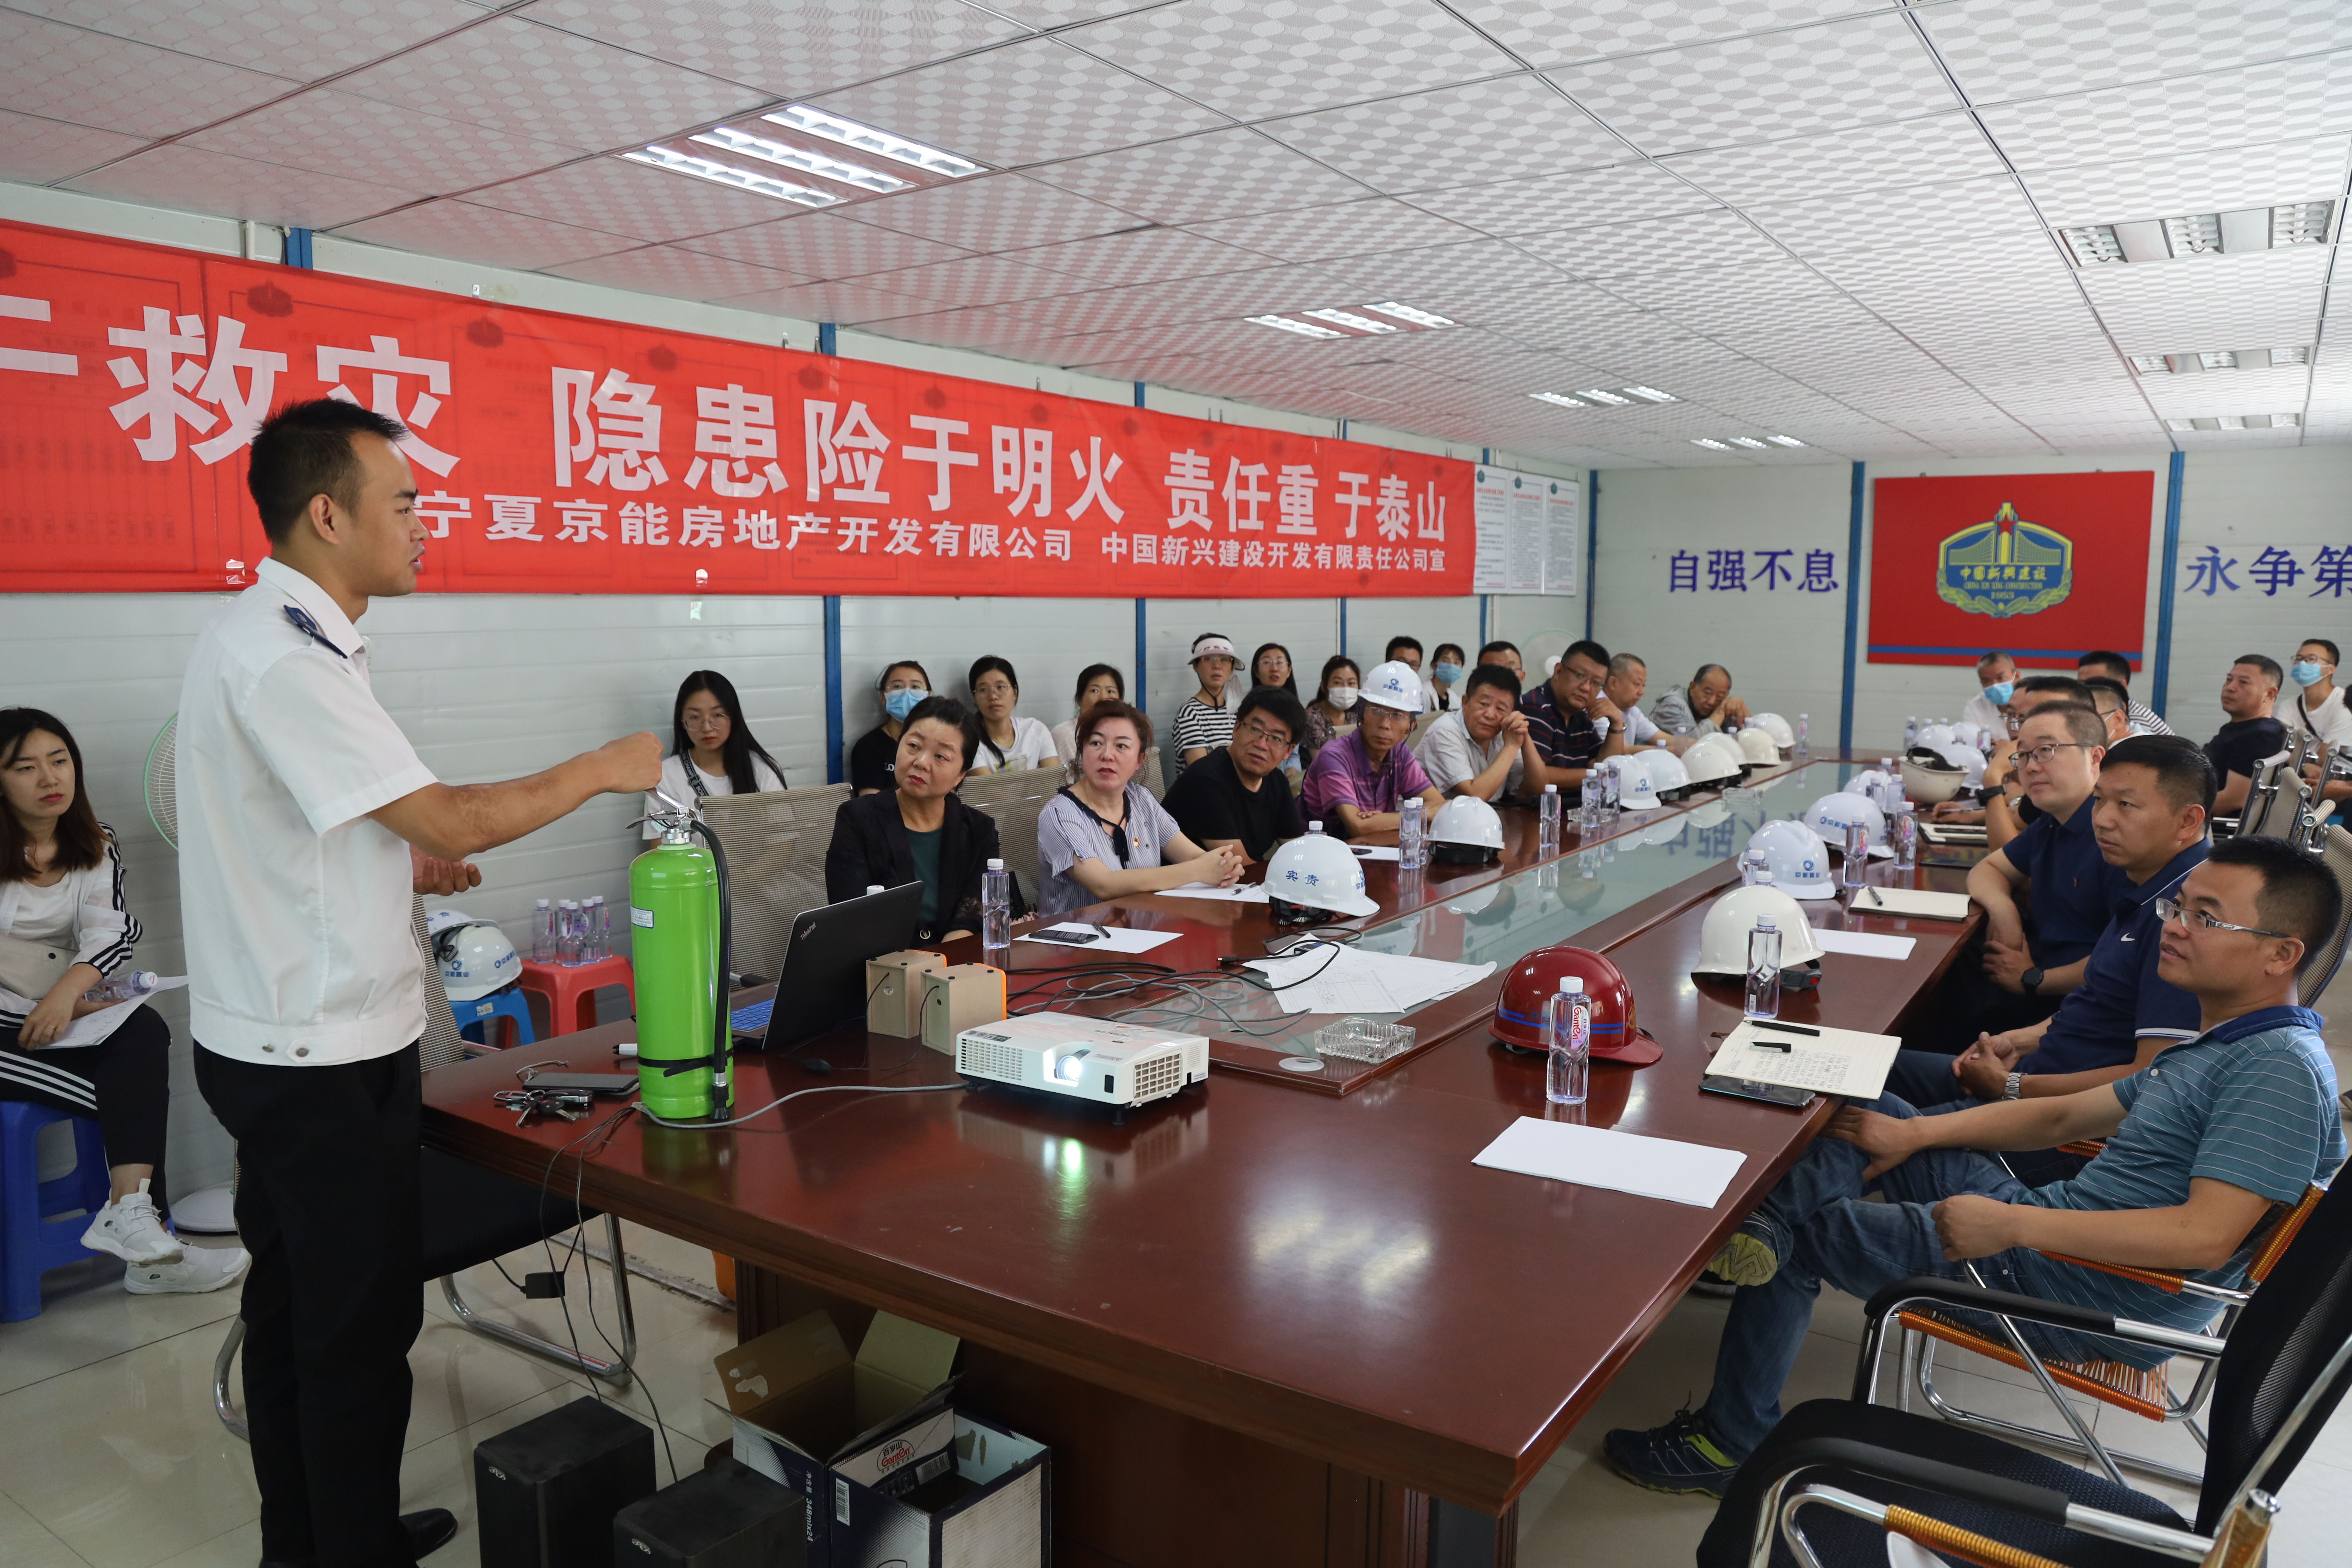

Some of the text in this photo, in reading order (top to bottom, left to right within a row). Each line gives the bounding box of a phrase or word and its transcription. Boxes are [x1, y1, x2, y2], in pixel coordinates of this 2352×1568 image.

[551, 366, 1125, 524] 隐患险于明火
[1164, 448, 1446, 542] 责任重于泰山
[413, 490, 1071, 562] 宁夏京能房地产开发有限公司
[1101, 531, 1446, 572] 中国新兴建设开发有限责任公司宣
[1669, 549, 1839, 593] 自强不息
[2184, 545, 2352, 598] 永争第
[695, 785, 705, 796] BOR
[800, 922, 816, 940] ThinkPad
[1572, 1007, 1582, 1040] Ganten
[881, 1447, 911, 1467] Ganten
[883, 1441, 902, 1457] 百岁山
